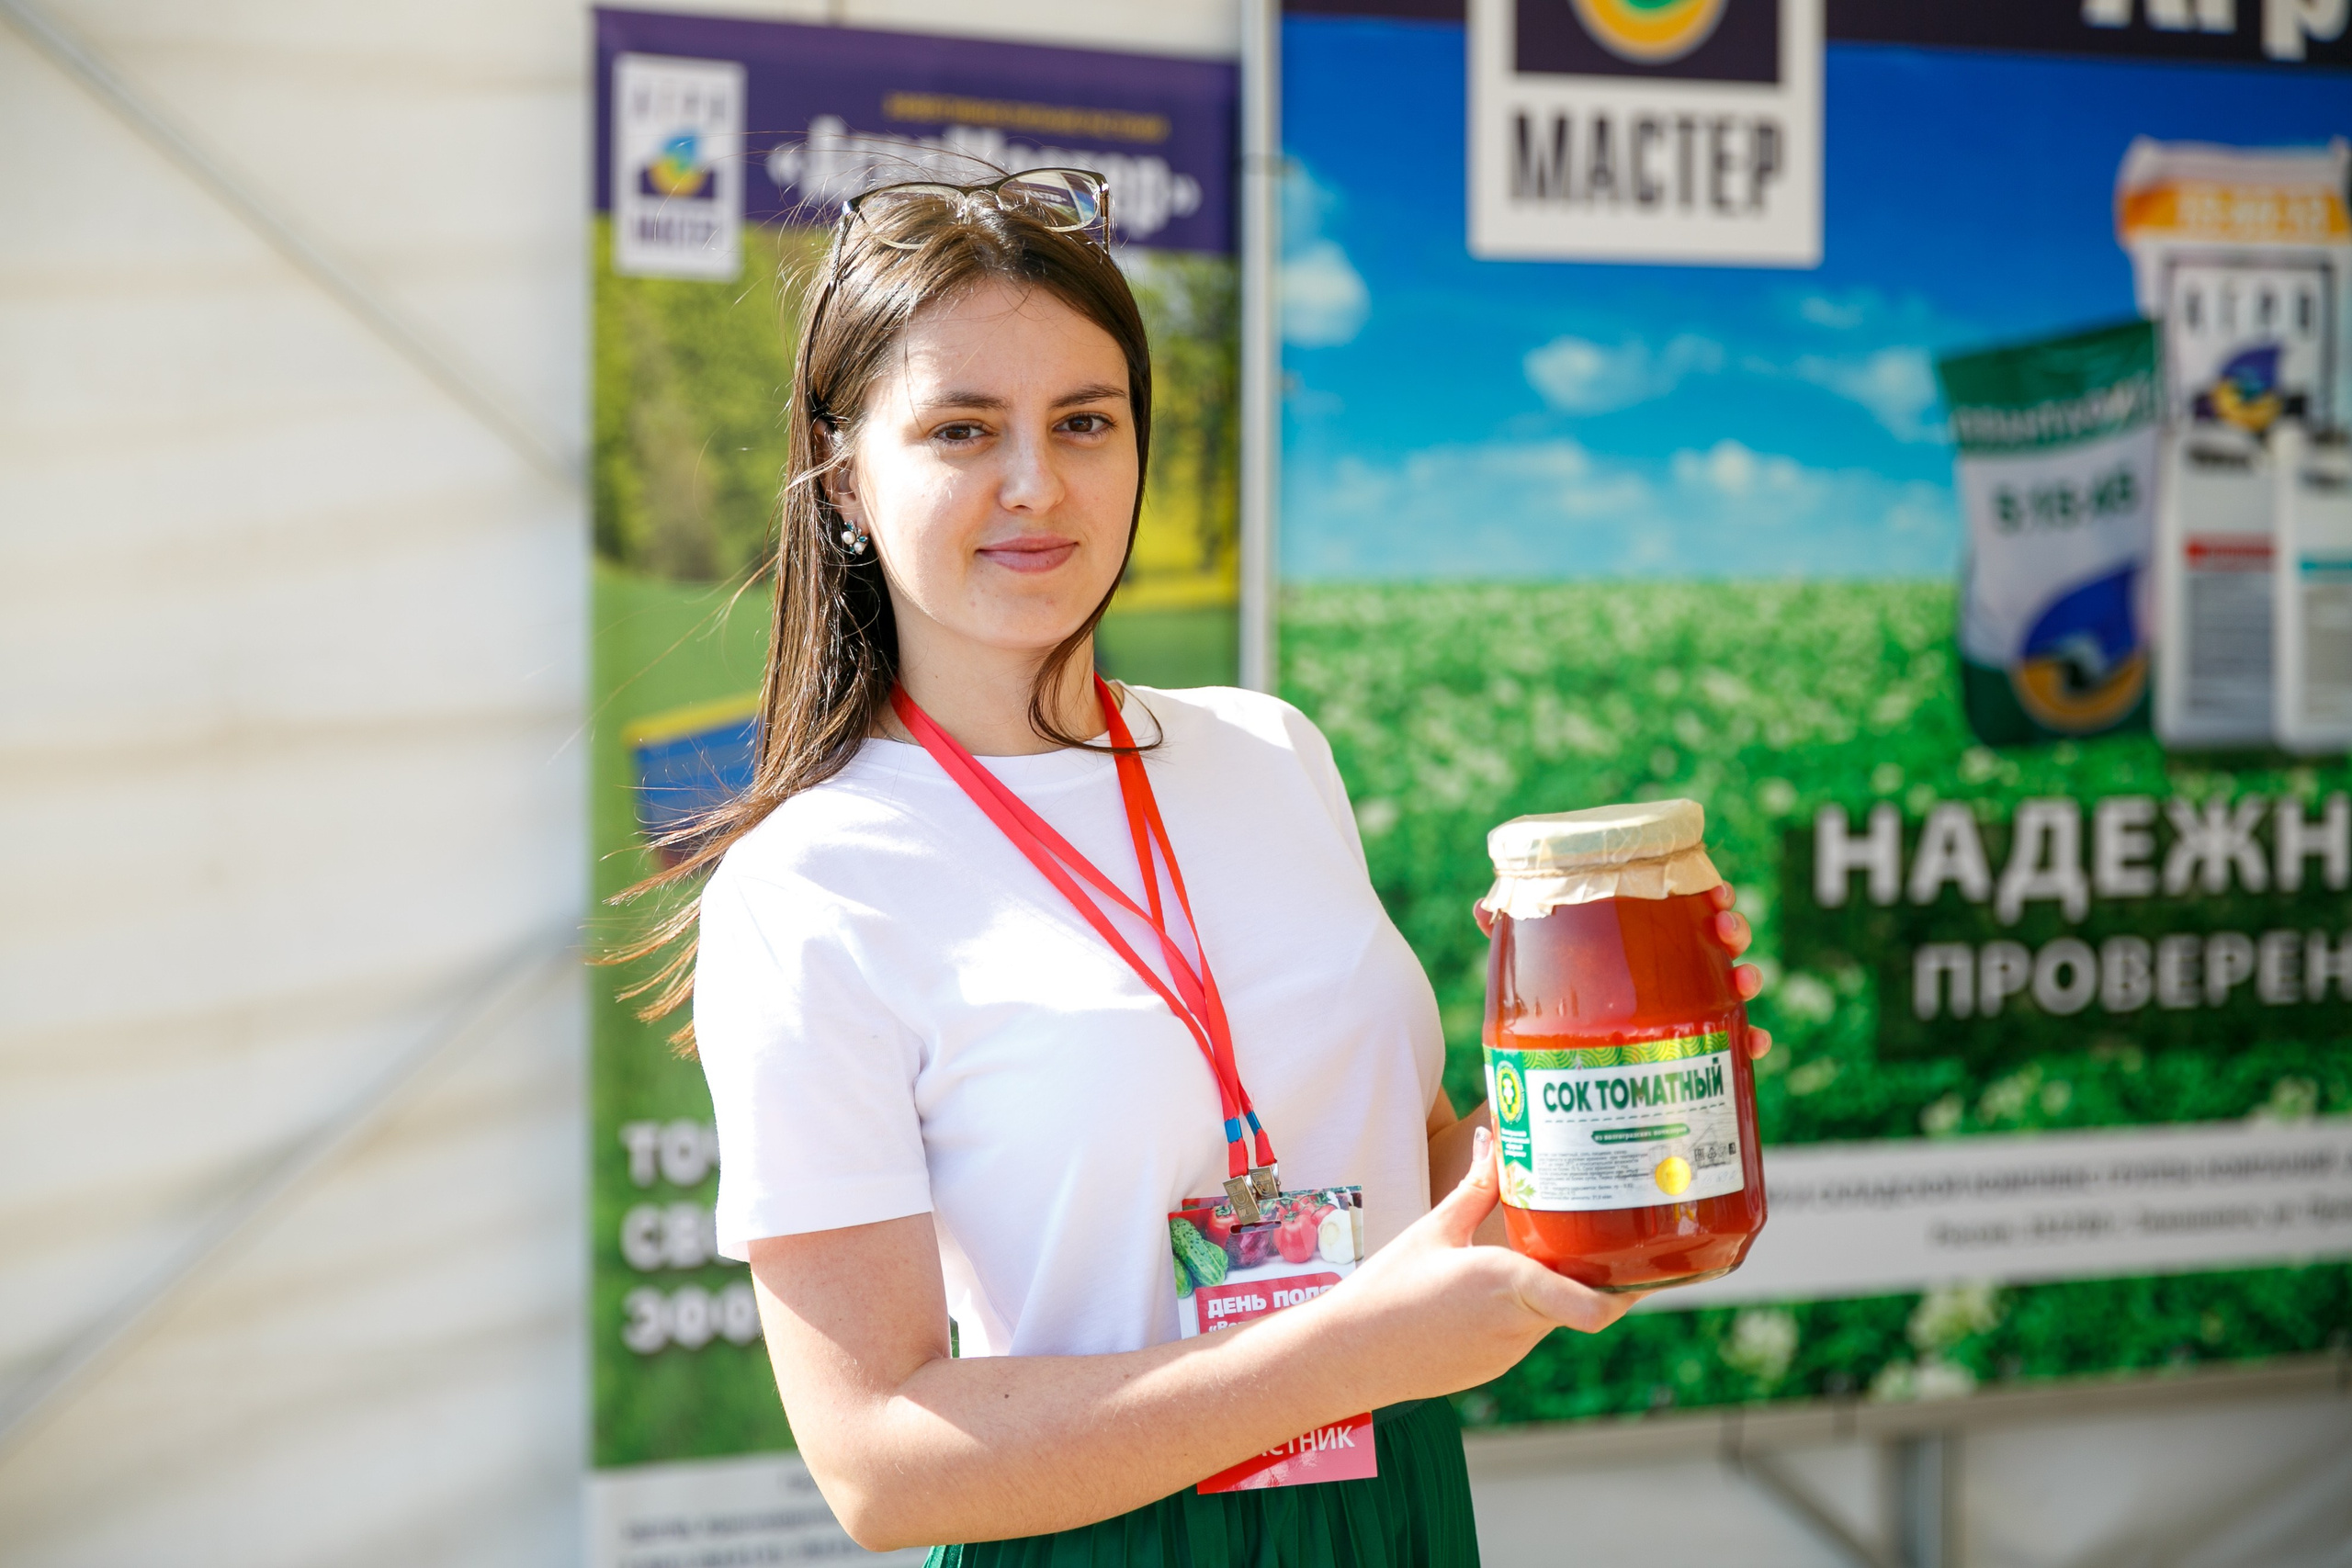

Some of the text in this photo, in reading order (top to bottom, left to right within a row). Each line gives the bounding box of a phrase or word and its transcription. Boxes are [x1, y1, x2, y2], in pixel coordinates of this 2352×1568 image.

[1510, 108, 1784, 217] МАСТЕР
[1814, 792, 2351, 926] НАДЕЖН
[1912, 929, 2352, 1017] ПРОВЕРЕН
[1543, 1081, 1592, 1112] СОК
[1595, 1057, 1724, 1111] ТОМАТНЫЙ
[1604, 1131, 1652, 1141] волгоградских
[1207, 1294, 1267, 1319] ДЕНЬ
[1261, 1425, 1356, 1457] ТНИК
